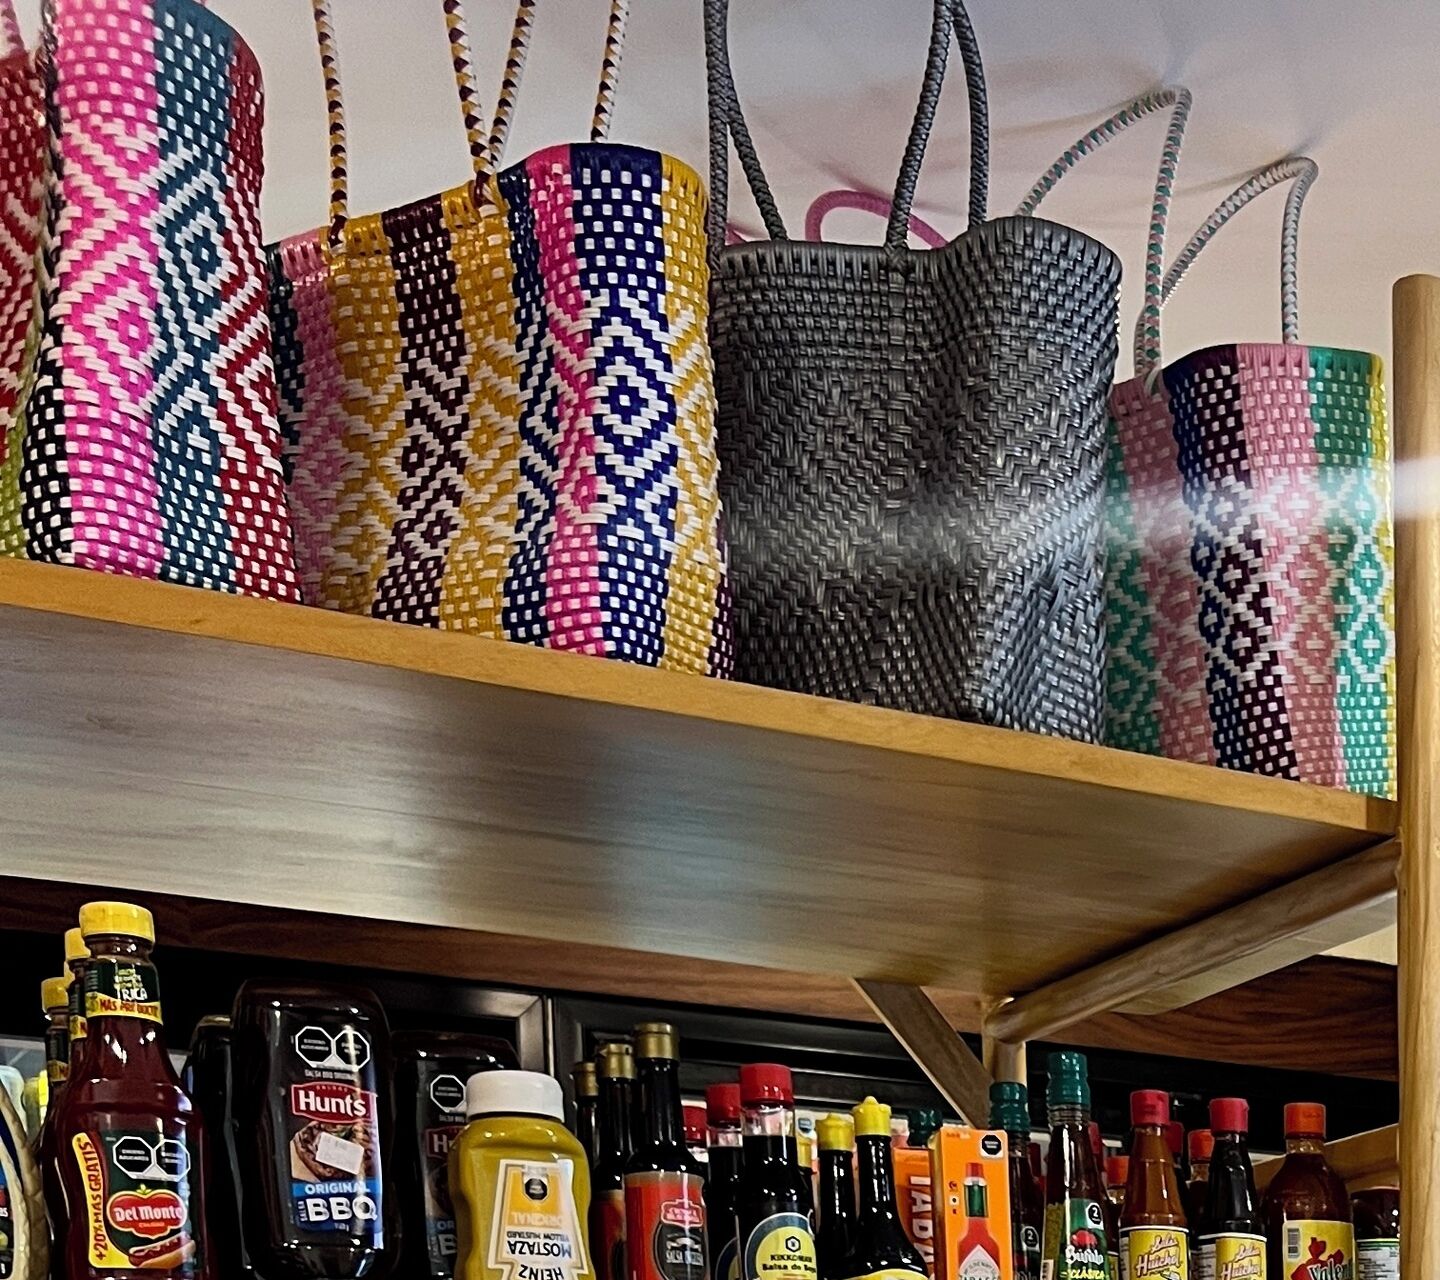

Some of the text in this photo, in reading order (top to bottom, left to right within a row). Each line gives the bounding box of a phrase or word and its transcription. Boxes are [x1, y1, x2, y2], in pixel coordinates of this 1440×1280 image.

[298, 1089, 367, 1117] Hunts
[79, 1141, 103, 1192] GRATIS
[305, 1181, 370, 1195] ORIGINAL
[113, 1206, 183, 1222] Del Monte
[305, 1195, 378, 1222] BBQ
[507, 1240, 572, 1259] MOSTAZA
